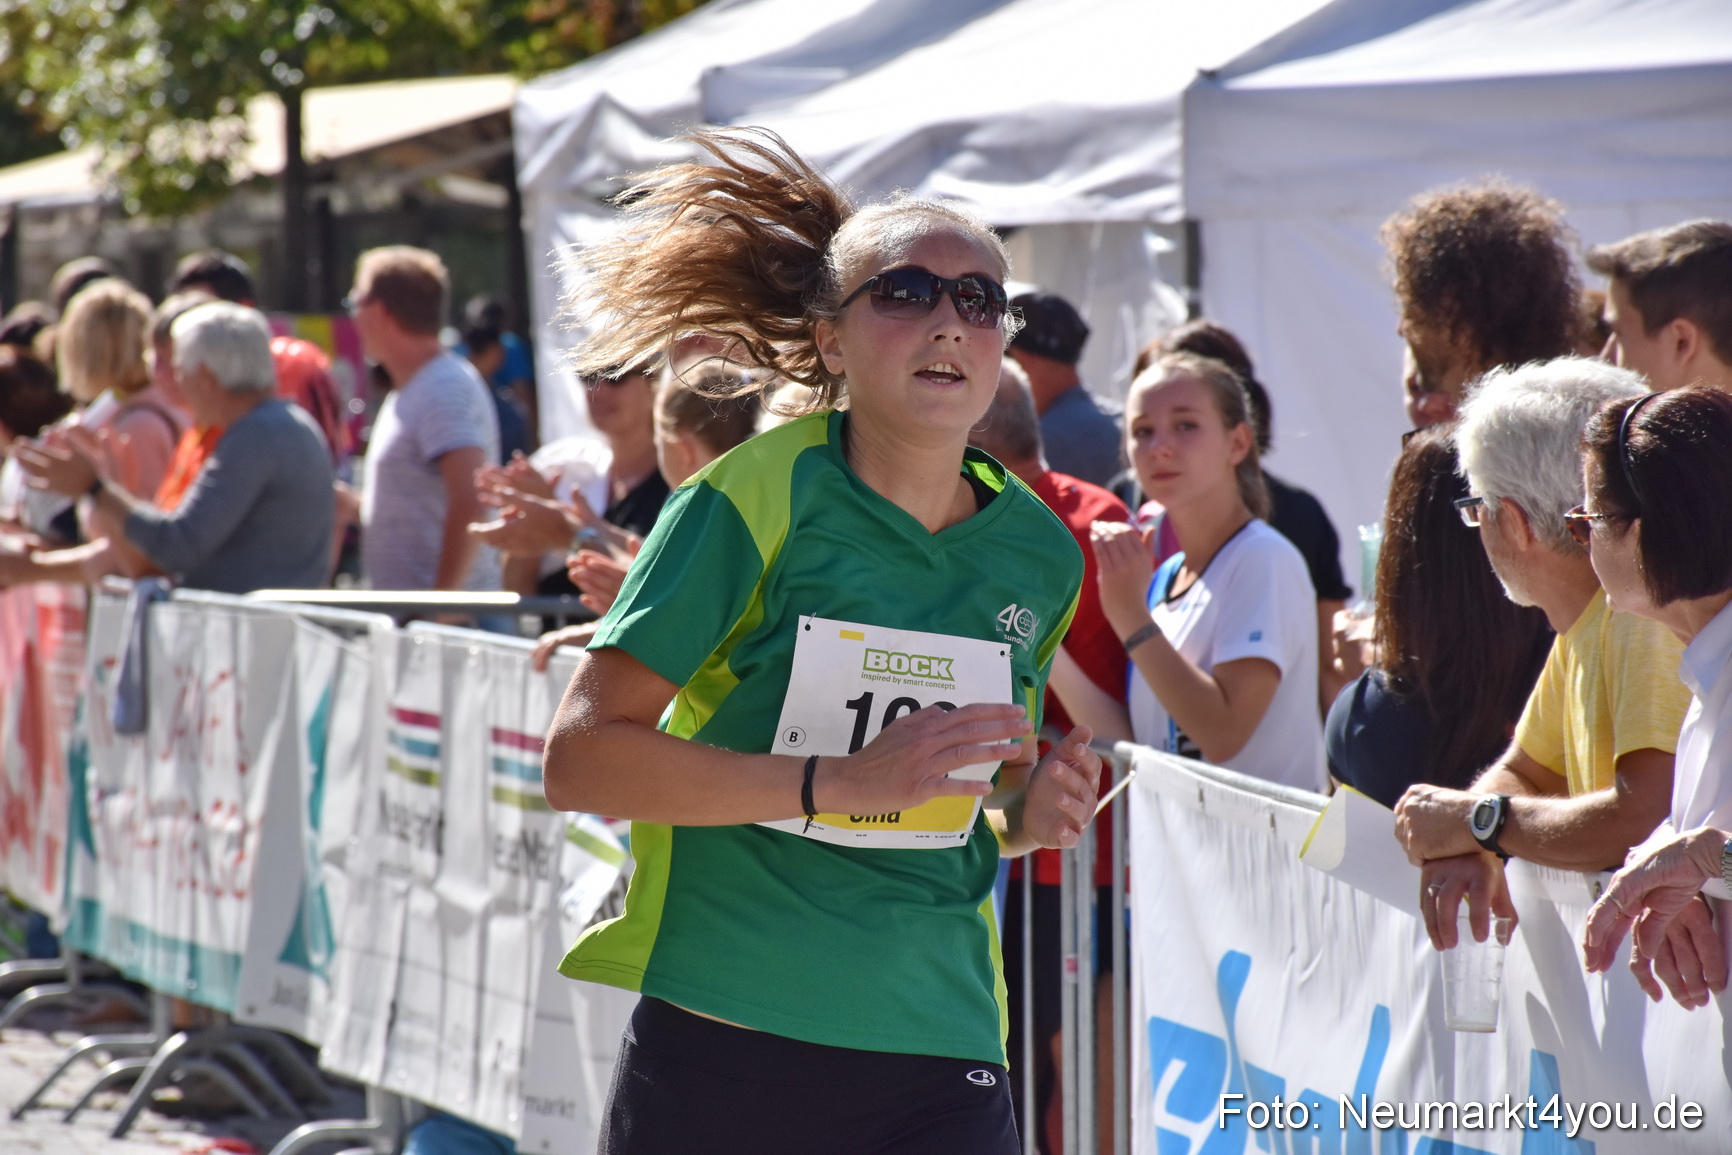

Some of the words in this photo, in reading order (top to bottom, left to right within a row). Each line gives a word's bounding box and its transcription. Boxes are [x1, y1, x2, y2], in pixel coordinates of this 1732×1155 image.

[863, 648, 956, 681] BOCK
[860, 671, 891, 683] inspired
[892, 675, 902, 685] by
[902, 677, 924, 687] smart
[924, 680, 956, 691] concepts
[788, 731, 799, 743] B
